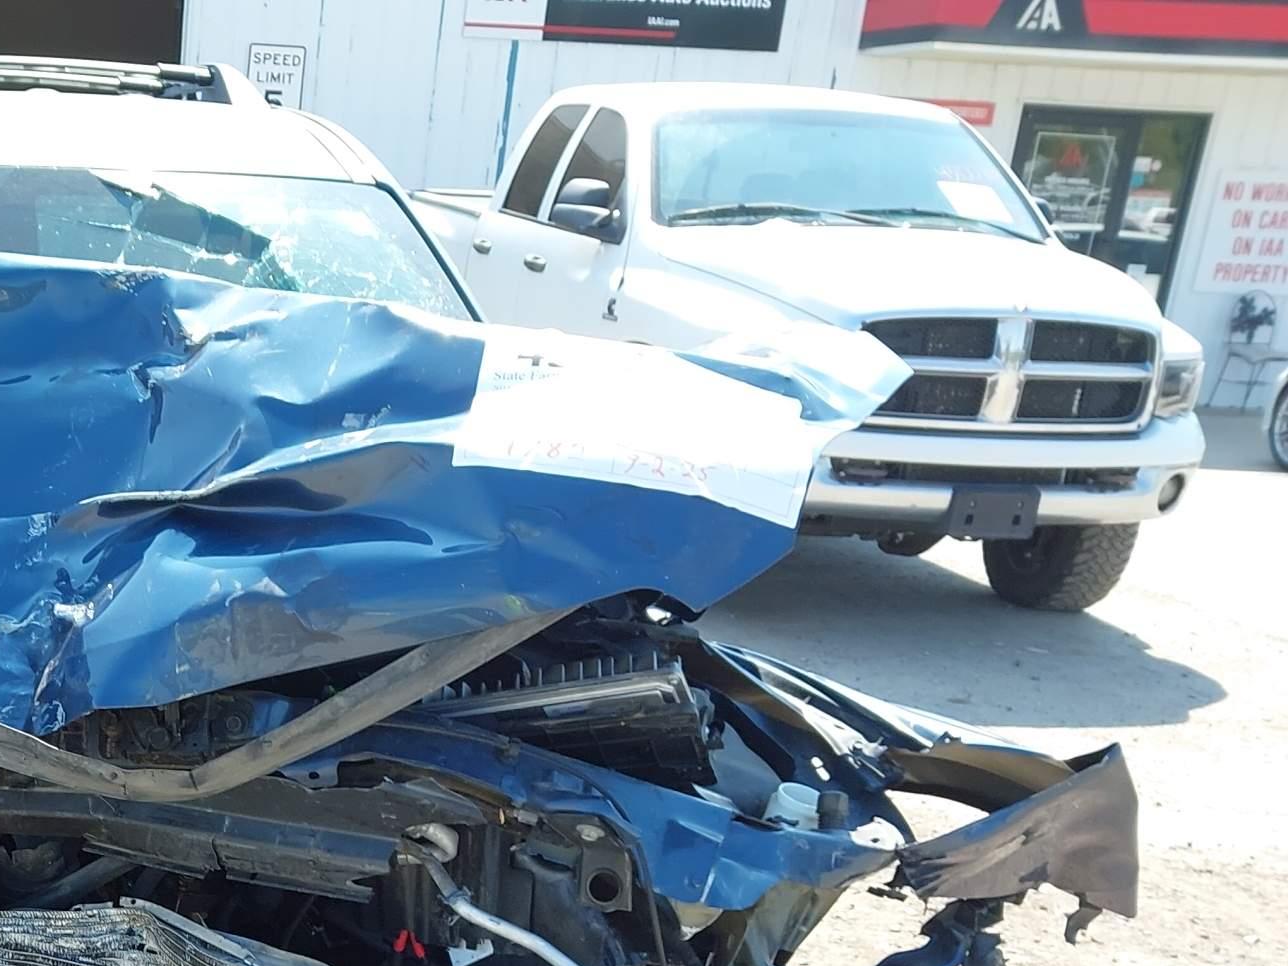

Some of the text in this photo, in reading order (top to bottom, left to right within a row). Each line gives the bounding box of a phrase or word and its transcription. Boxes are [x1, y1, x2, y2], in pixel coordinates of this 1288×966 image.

[253, 52, 302, 67] SPEED
[256, 71, 294, 84] LIMIT
[1223, 181, 1288, 202] NO WOR
[1232, 208, 1253, 229] ON
[1232, 236, 1254, 256] ON
